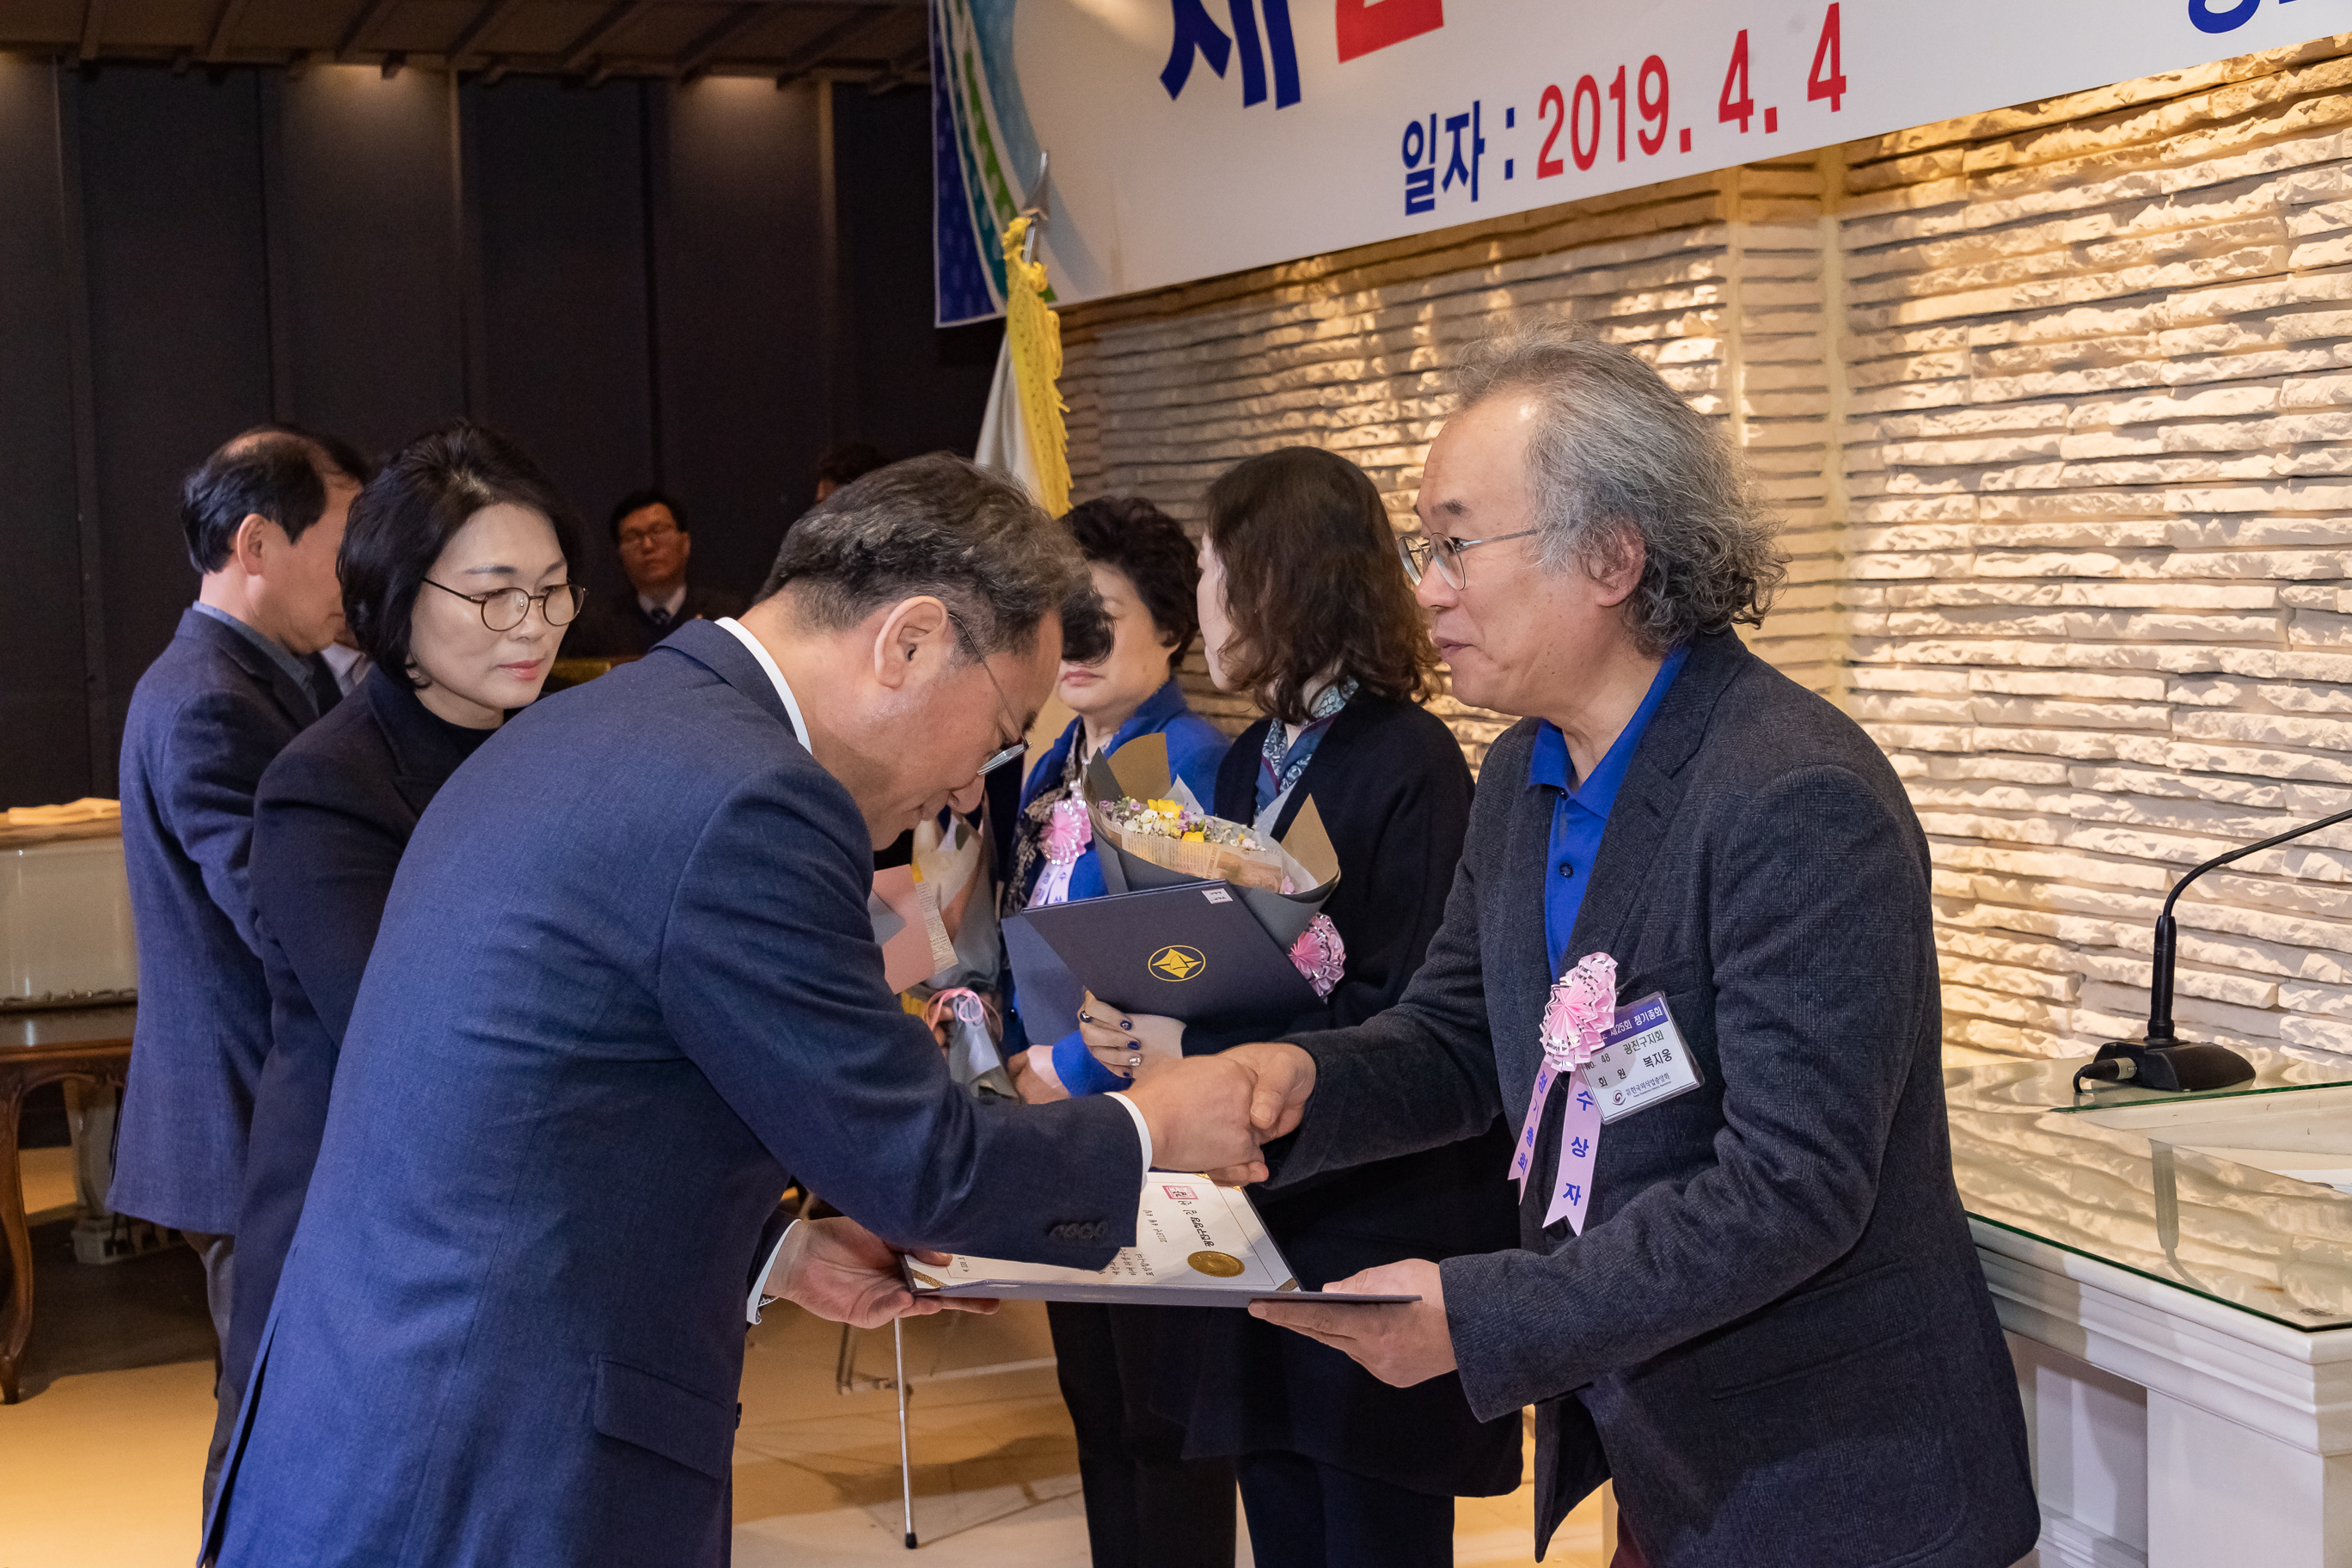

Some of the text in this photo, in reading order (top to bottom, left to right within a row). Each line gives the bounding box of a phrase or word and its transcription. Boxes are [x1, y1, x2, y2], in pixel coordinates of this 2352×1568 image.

[1401, 100, 1485, 216] 일자
[1537, 55, 1692, 180] 2019.
[1718, 28, 1777, 134] 4.
[1807, 2, 1847, 113] 4
[1633, 1005, 1663, 1026] 정기총회
[1622, 1029, 1665, 1055] 광진구지회
[1601, 1052, 1611, 1064] 48
[1643, 1048, 1673, 1069] 복지웅
